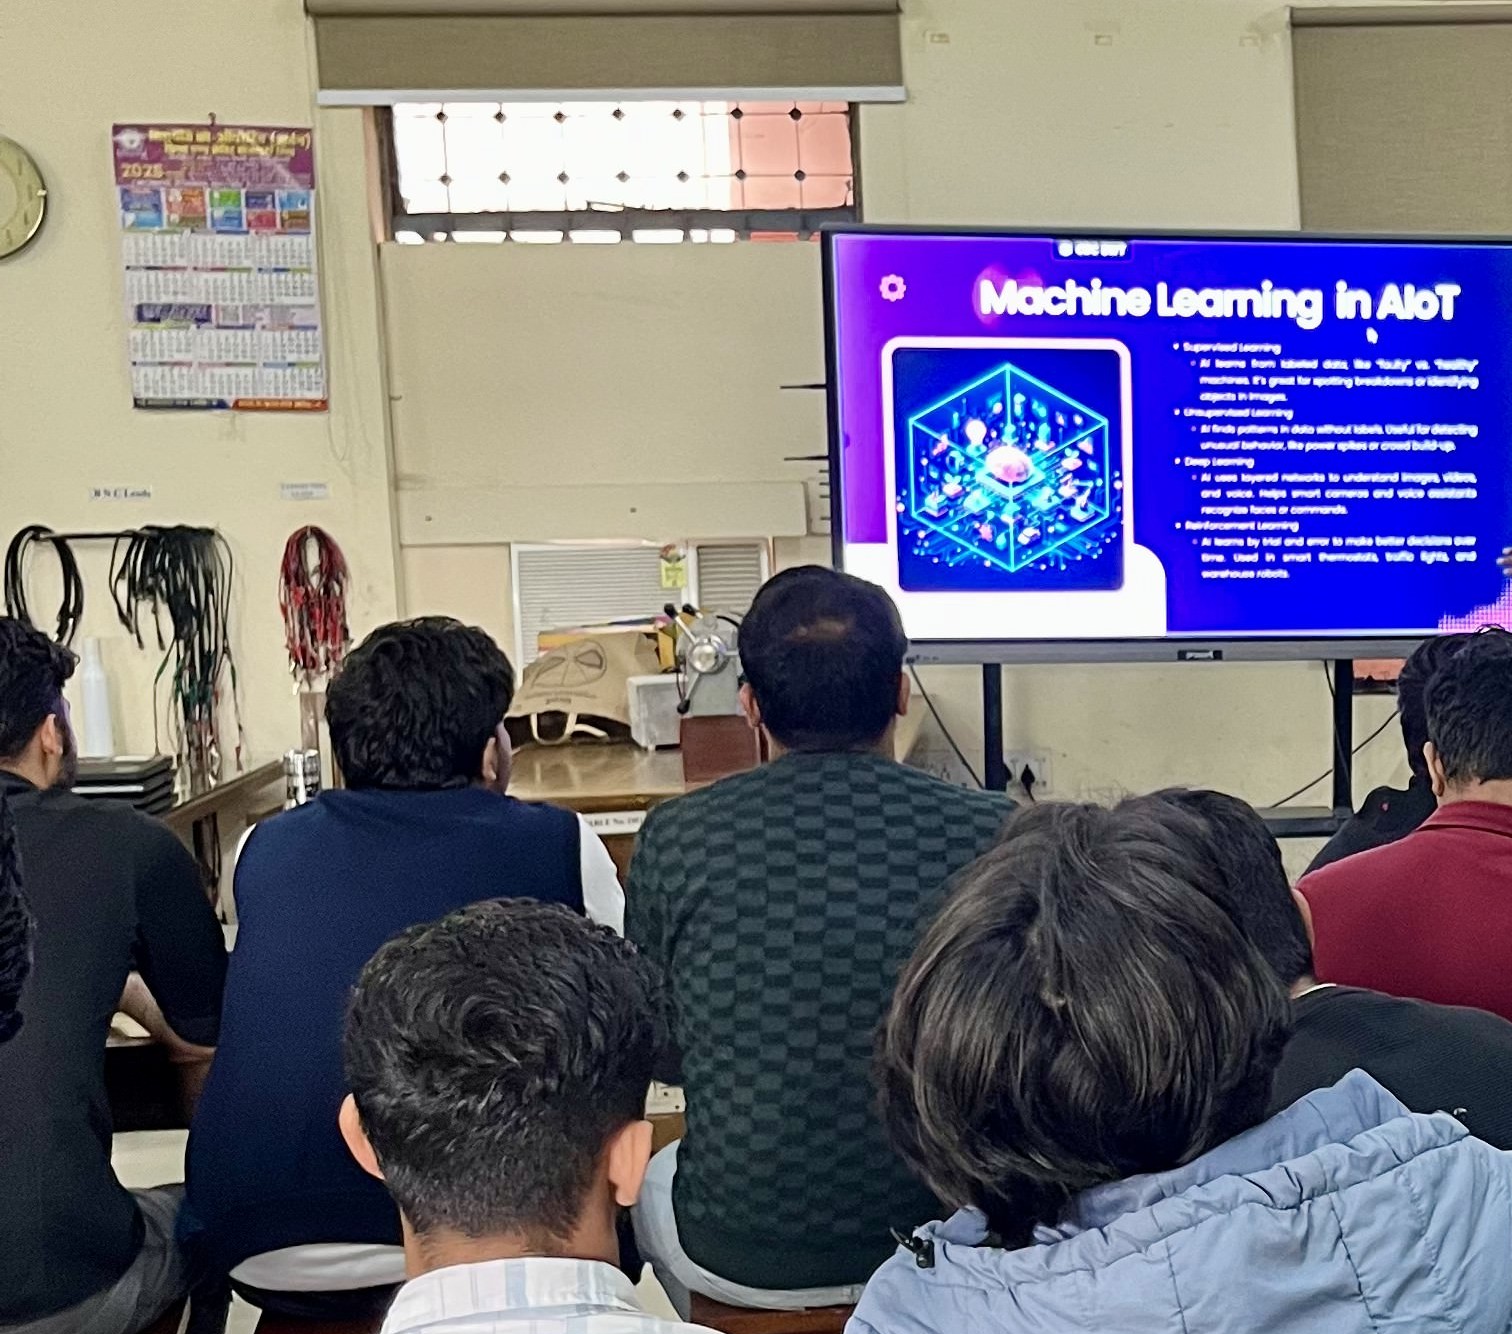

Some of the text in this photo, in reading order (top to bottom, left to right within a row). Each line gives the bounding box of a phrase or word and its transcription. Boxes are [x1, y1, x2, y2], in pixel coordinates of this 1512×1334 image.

[979, 278, 1152, 318] Machine
[1156, 279, 1322, 330] Learning
[1335, 280, 1372, 320] in
[1239, 343, 1281, 355] Learning
[1251, 409, 1294, 420] Learning
[1212, 457, 1254, 468] Learning
[1201, 489, 1221, 498] and
[1373, 488, 1394, 498] and
[1257, 521, 1299, 532] Learning
[1284, 537, 1304, 546] and
